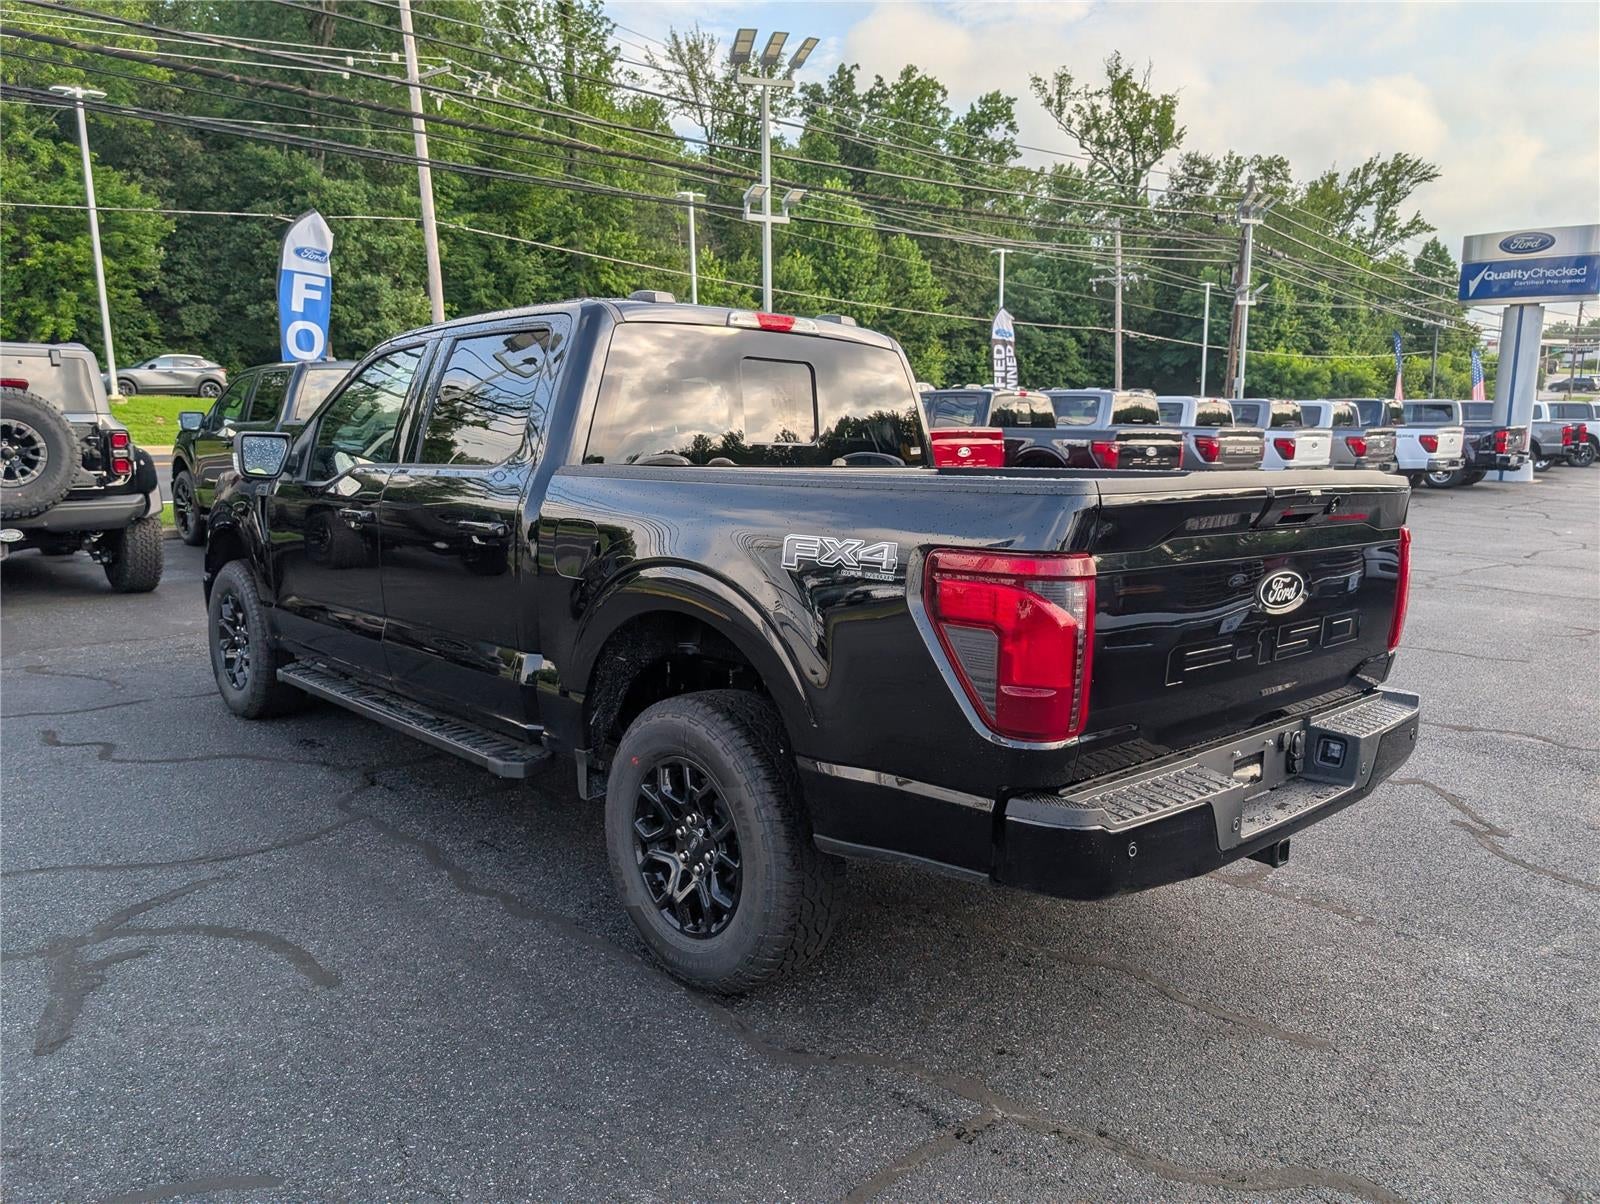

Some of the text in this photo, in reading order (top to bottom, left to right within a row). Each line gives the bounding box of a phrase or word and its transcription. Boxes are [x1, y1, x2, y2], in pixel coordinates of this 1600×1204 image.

[1509, 236, 1542, 250] Ford
[300, 247, 328, 263] Ford
[781, 534, 898, 574] FX4
